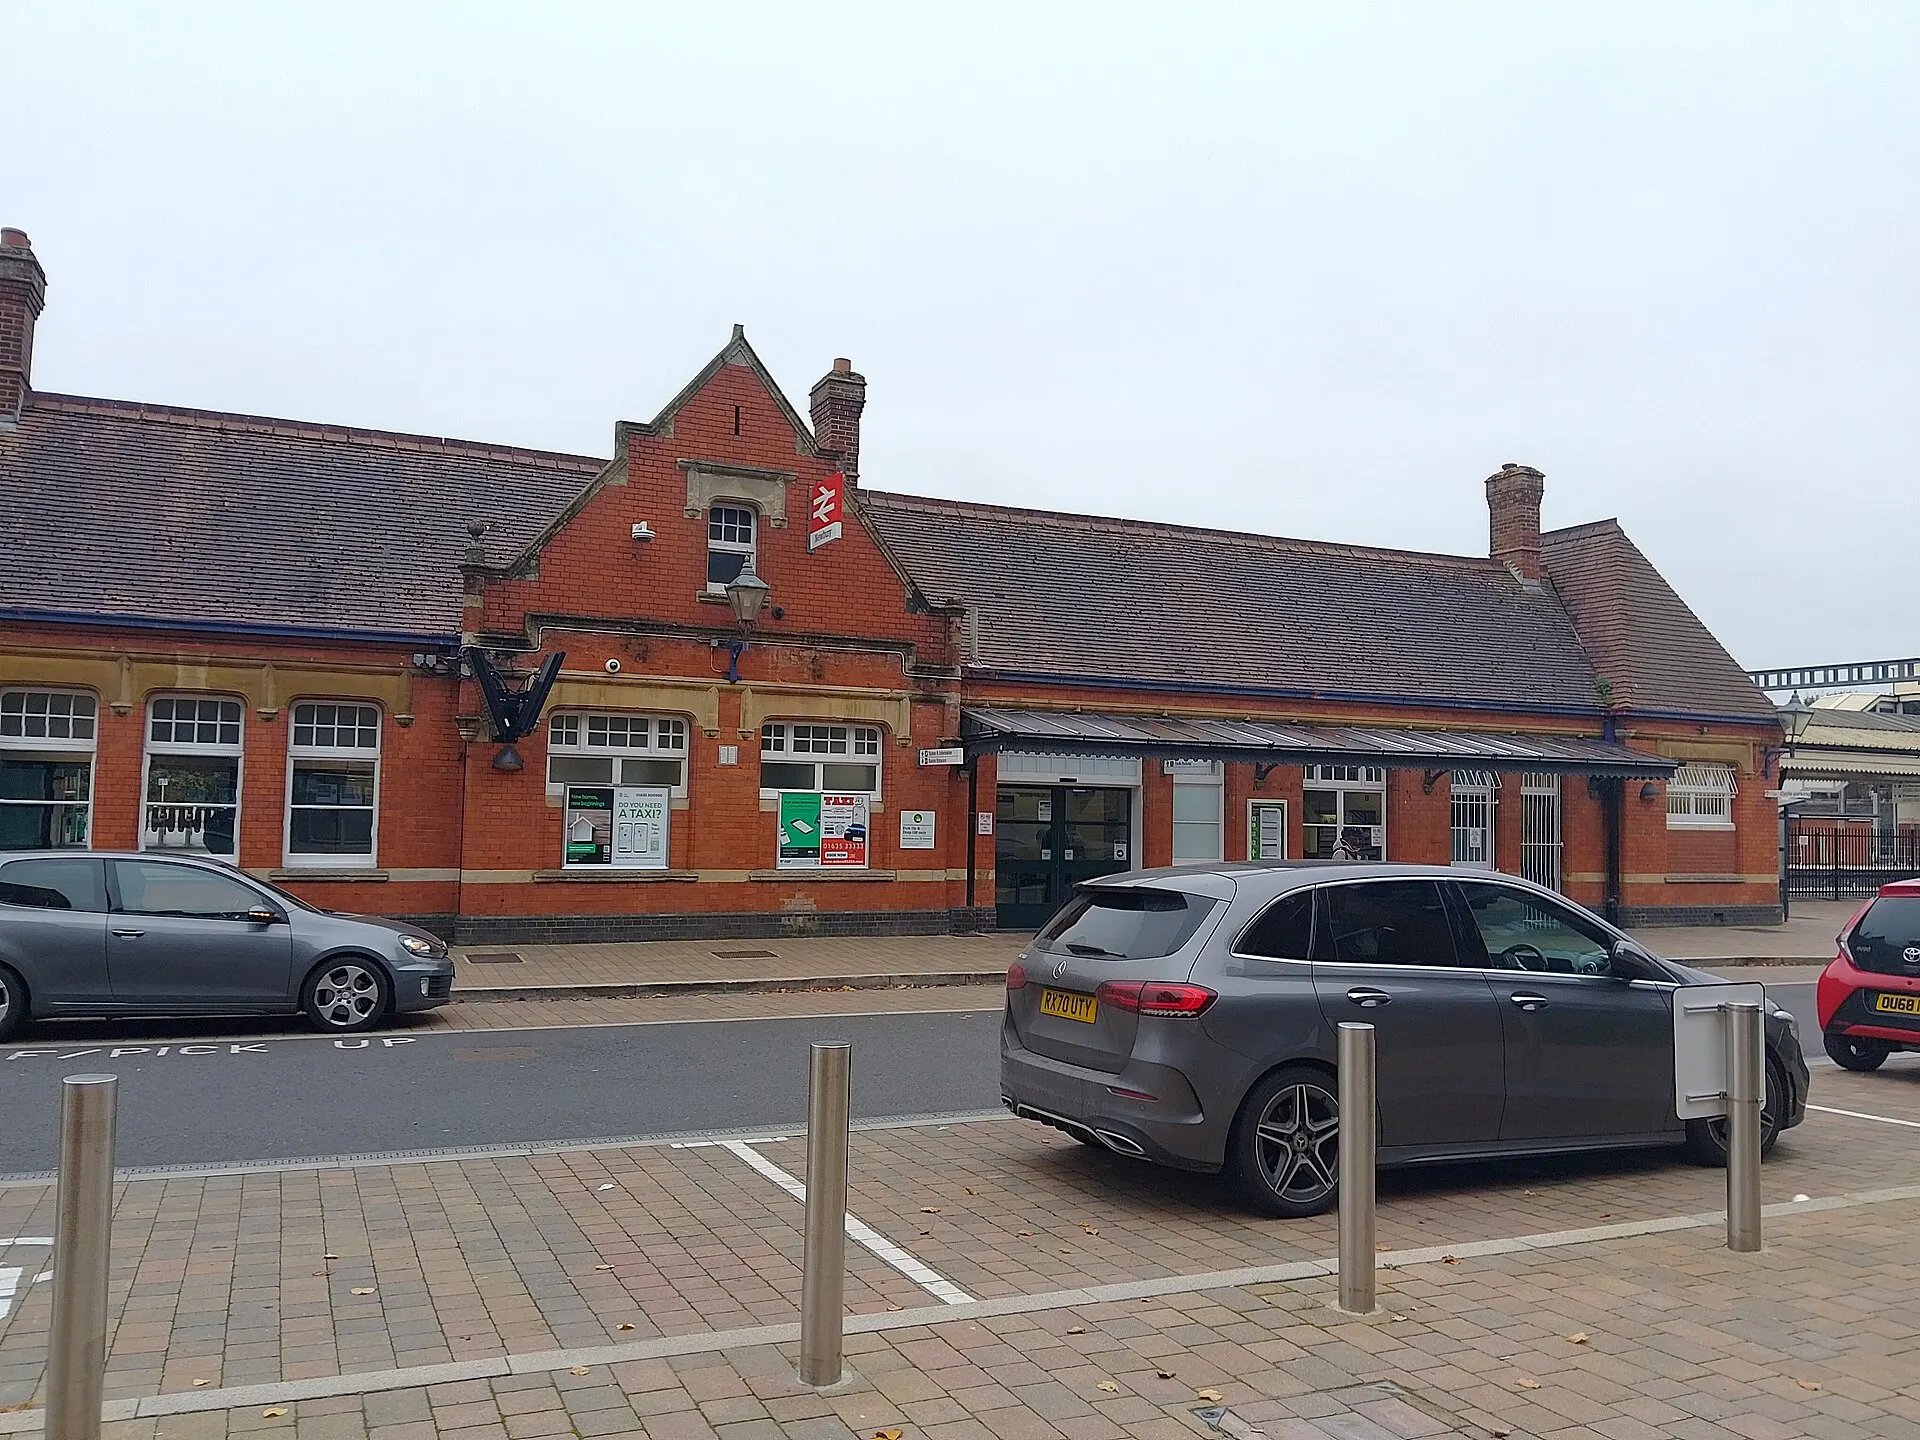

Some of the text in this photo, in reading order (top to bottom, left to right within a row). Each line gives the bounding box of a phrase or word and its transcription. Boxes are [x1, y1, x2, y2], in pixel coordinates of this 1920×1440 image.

[823, 797, 854, 805] TAXI
[618, 808, 662, 819] A TAXI?
[1044, 992, 1092, 1017] RX70 UTY
[1882, 996, 1914, 1011] OU68
[333, 1037, 417, 1050] UP
